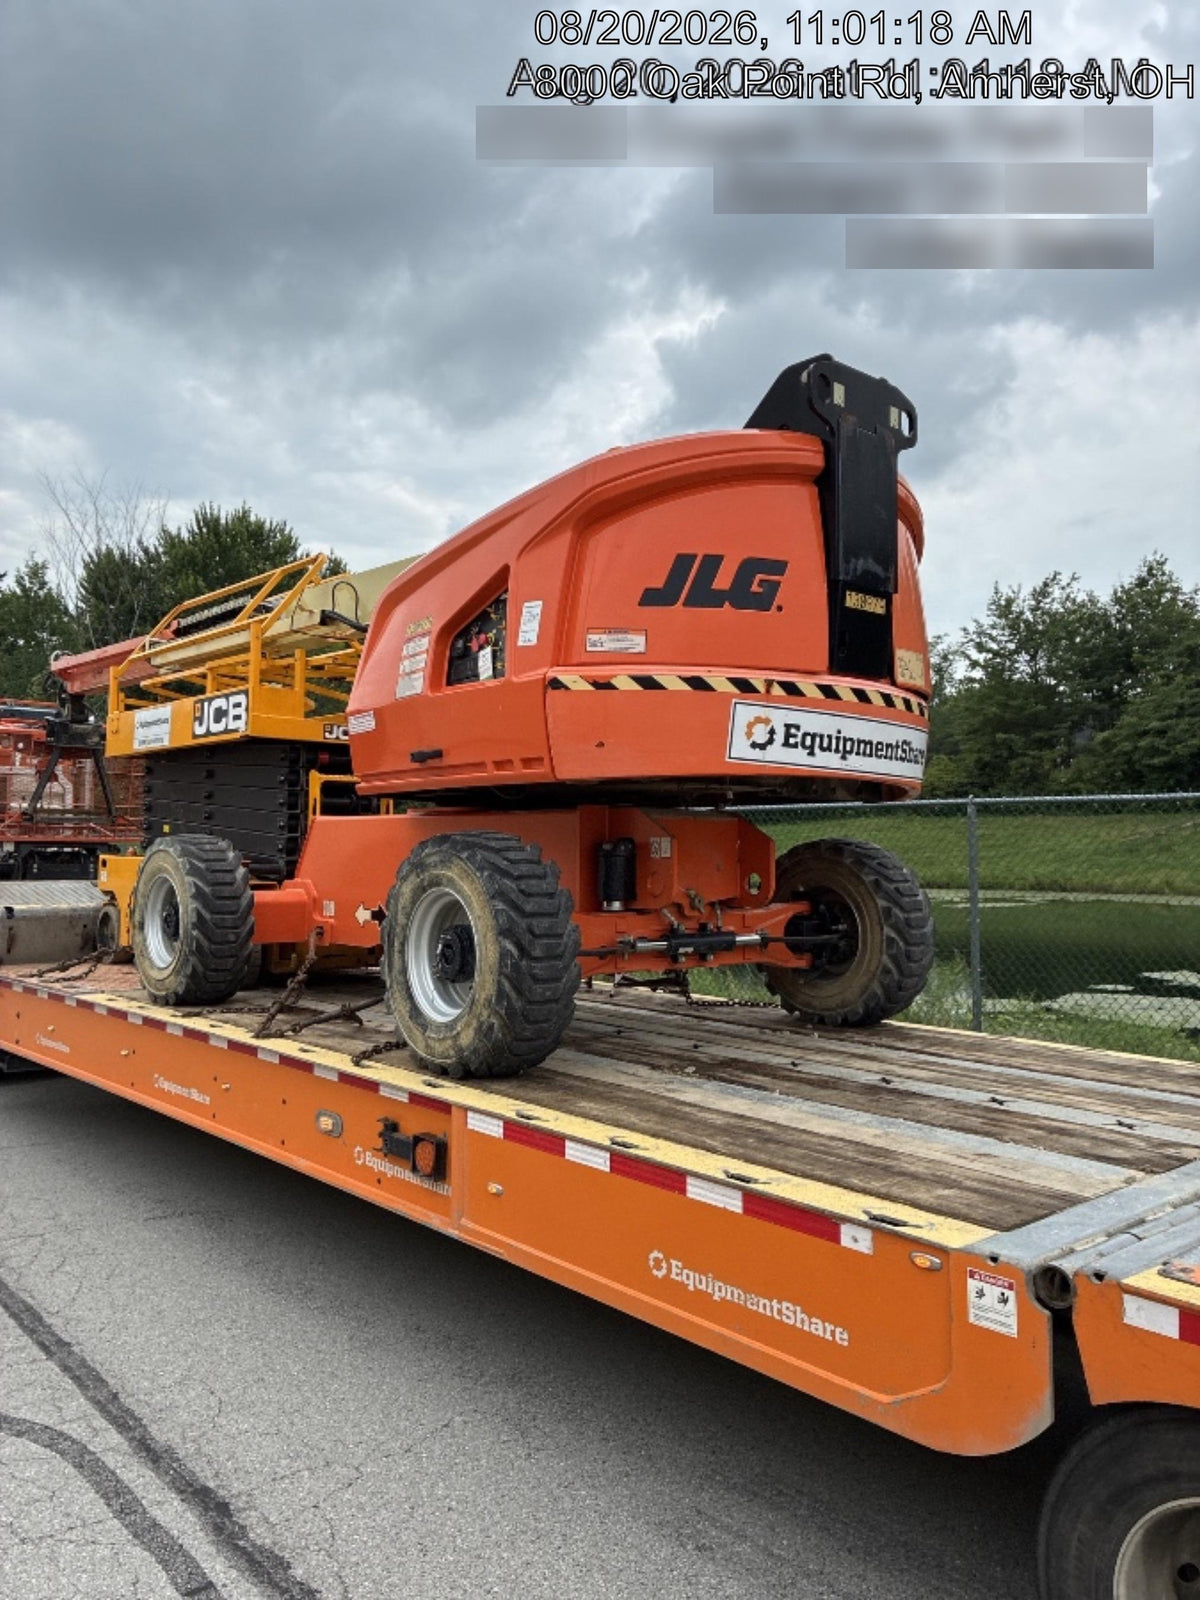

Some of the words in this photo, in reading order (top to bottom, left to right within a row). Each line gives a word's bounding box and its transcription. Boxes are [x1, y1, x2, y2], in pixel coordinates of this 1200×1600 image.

[638, 553, 789, 612] JLG
[194, 694, 248, 736] JCB
[325, 724, 349, 740] JC
[782, 723, 925, 766] EquipmentShar
[670, 1259, 849, 1346] EquipmentShare
